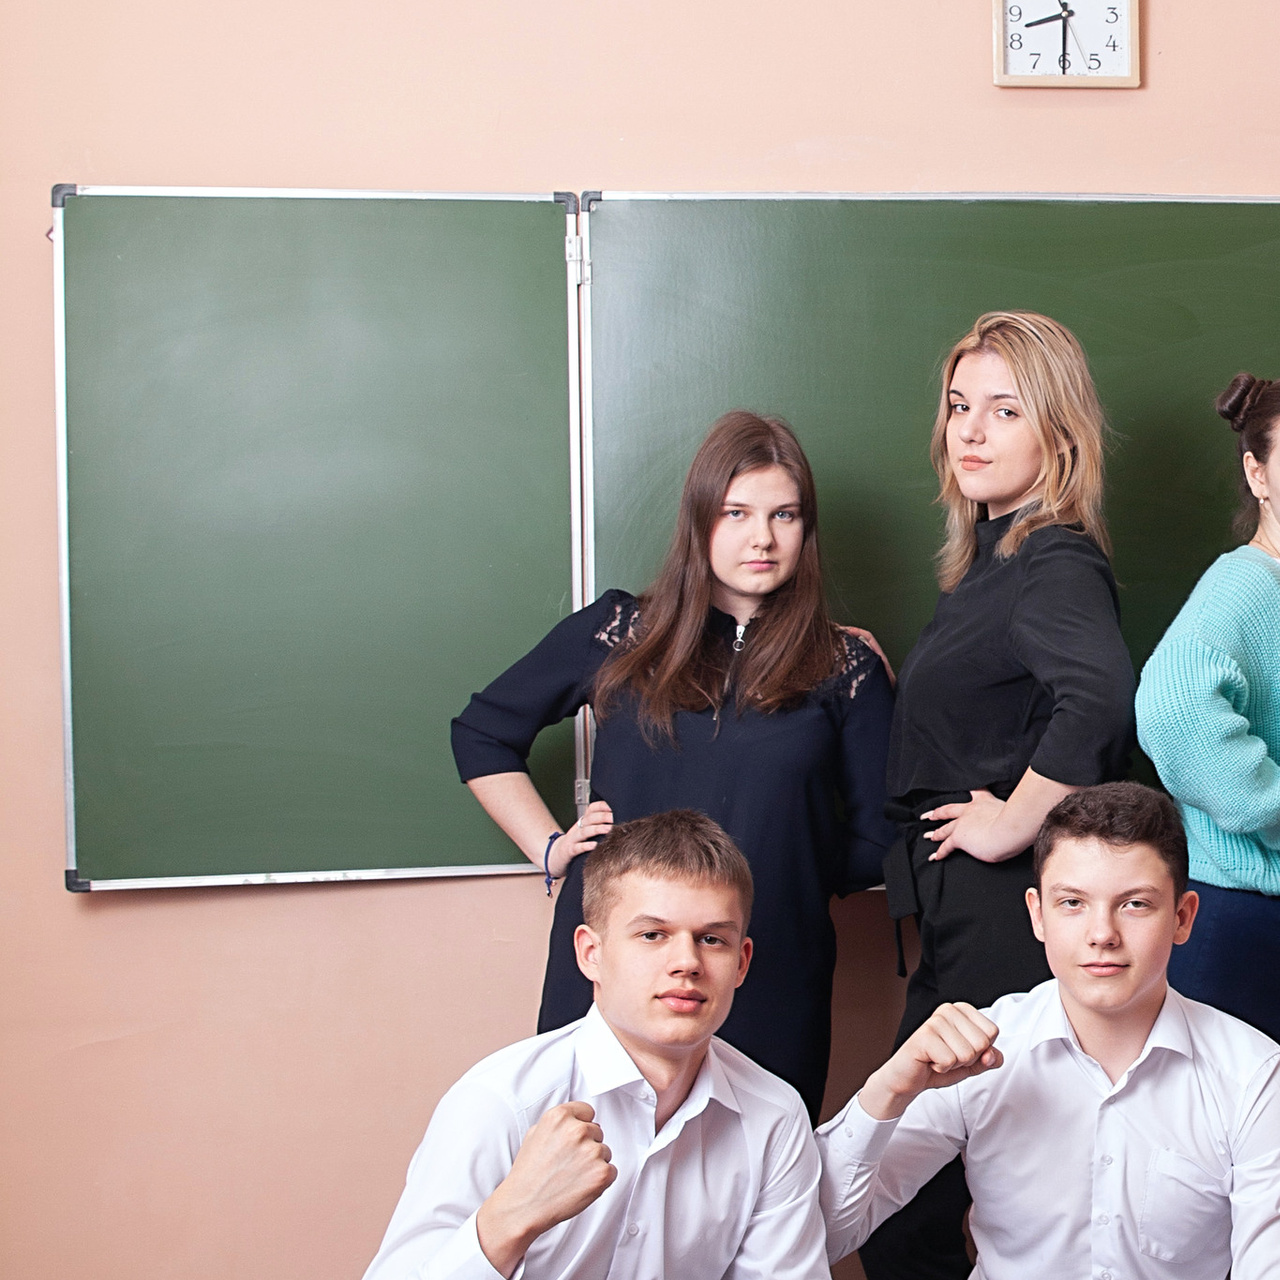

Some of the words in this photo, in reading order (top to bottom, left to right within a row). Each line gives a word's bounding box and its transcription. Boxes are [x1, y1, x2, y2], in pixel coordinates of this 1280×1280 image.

[1009, 5, 1022, 23] 9
[1105, 7, 1119, 24] 3
[1009, 33, 1023, 50] 8
[1105, 35, 1119, 52] 4
[1029, 53, 1041, 70] 7
[1058, 53, 1072, 70] 6
[1088, 53, 1102, 70] 5
